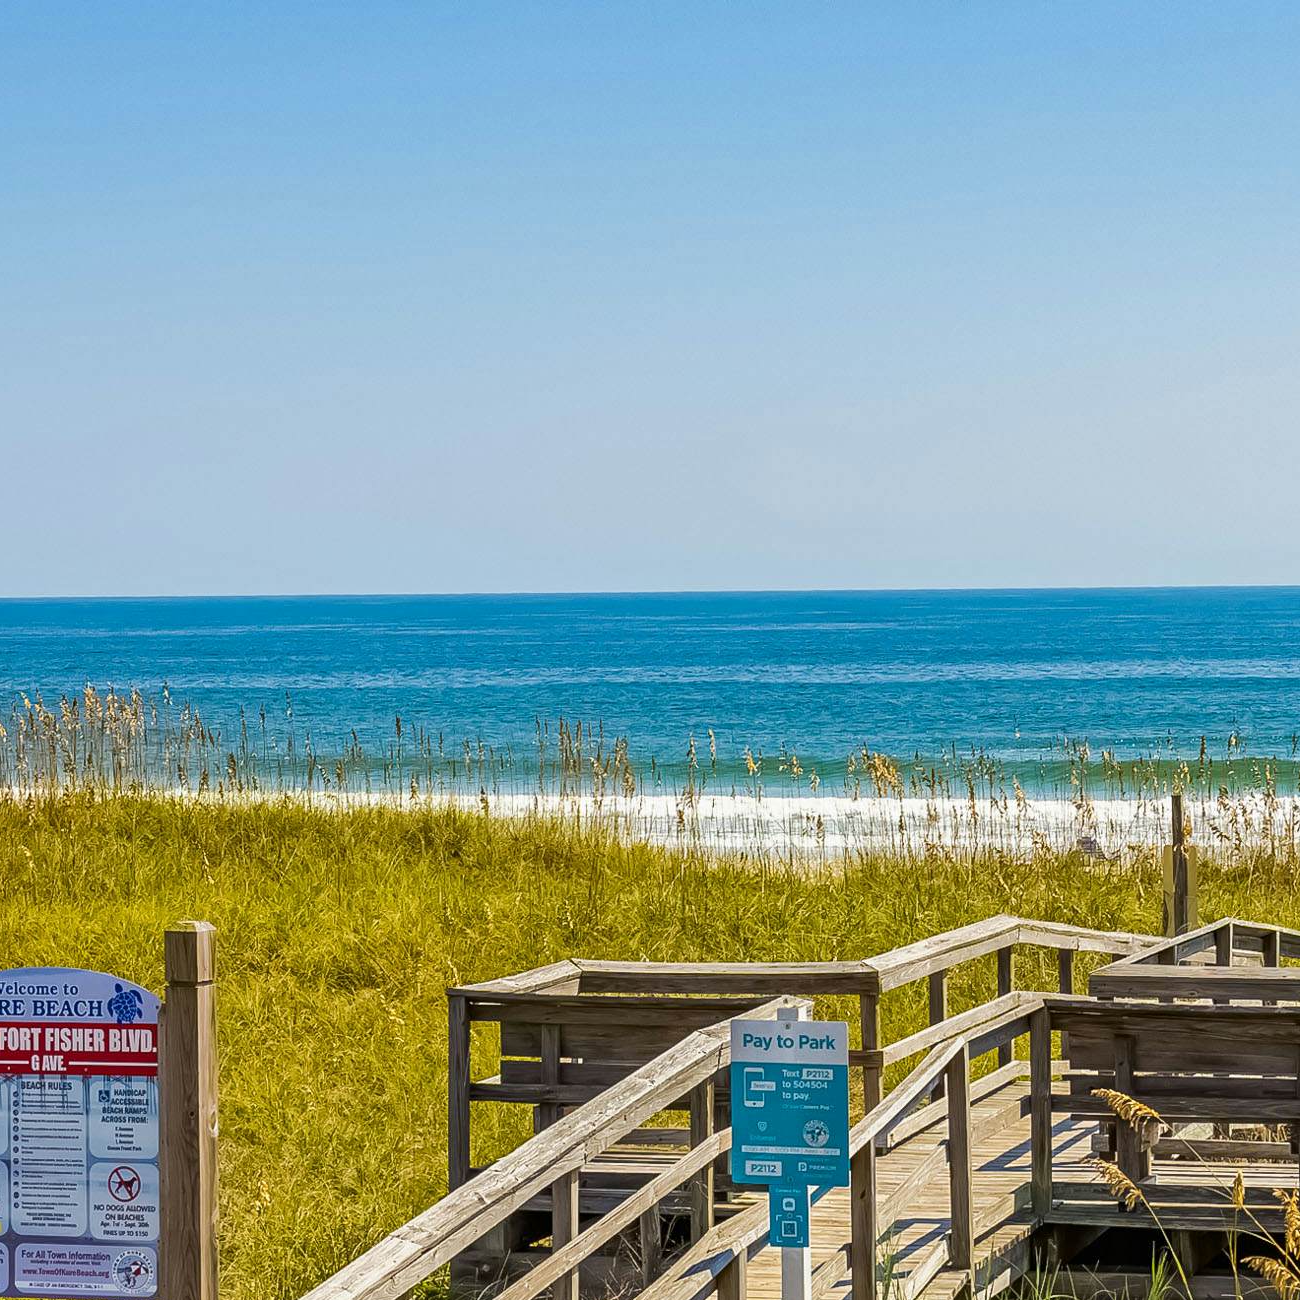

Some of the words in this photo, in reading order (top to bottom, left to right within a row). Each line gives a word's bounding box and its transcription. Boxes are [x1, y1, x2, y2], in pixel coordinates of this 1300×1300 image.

[63, 983, 78, 995] to
[33, 1000, 103, 1017] BEACH
[45, 1028, 105, 1052] FISHER
[108, 1029, 157, 1053] BLVD.
[743, 1034, 772, 1050] Pay
[777, 1035, 794, 1048] to
[800, 1035, 835, 1049] Park
[31, 1055, 40, 1071] G
[42, 1056, 67, 1071] AVE.
[782, 1069, 800, 1077] Text
[806, 1070, 830, 1078] P2112
[21, 1081, 45, 1090] BEACH
[47, 1082, 72, 1090] RULES
[793, 1081, 828, 1089] 504504
[782, 1091, 791, 1099] to
[110, 1098, 149, 1106] ACCESSIBLE
[751, 1164, 776, 1173] P2112
[21, 1249, 34, 1258] For
[35, 1250, 45, 1259] All
[47, 1250, 67, 1259] Town
[68, 1251, 111, 1261] Information
